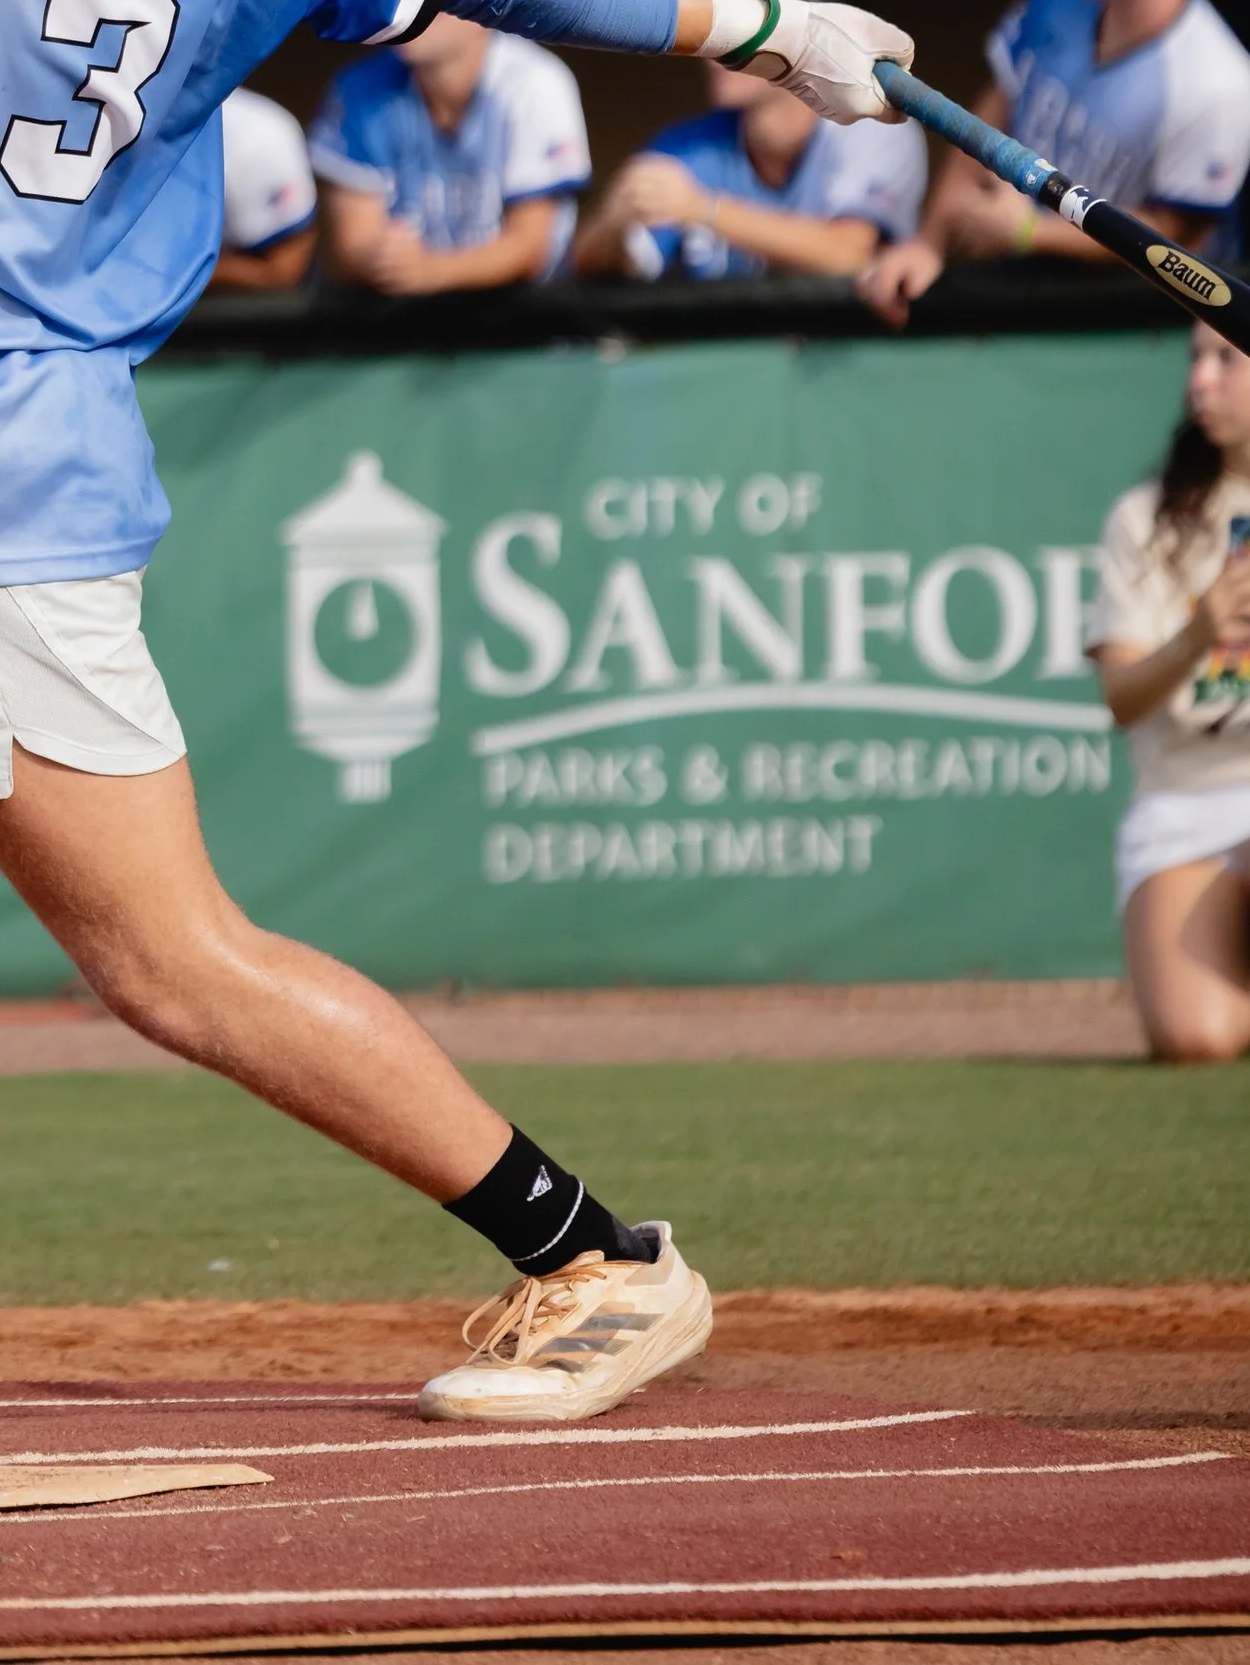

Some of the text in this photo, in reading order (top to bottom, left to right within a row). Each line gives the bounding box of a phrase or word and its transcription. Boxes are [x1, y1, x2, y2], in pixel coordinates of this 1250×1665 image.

[1158, 250, 1217, 301] Baum
[584, 472, 824, 540] CITY OF
[482, 735, 1111, 809] PARKS & RECREATION
[483, 813, 884, 884] DEPARTMENT
